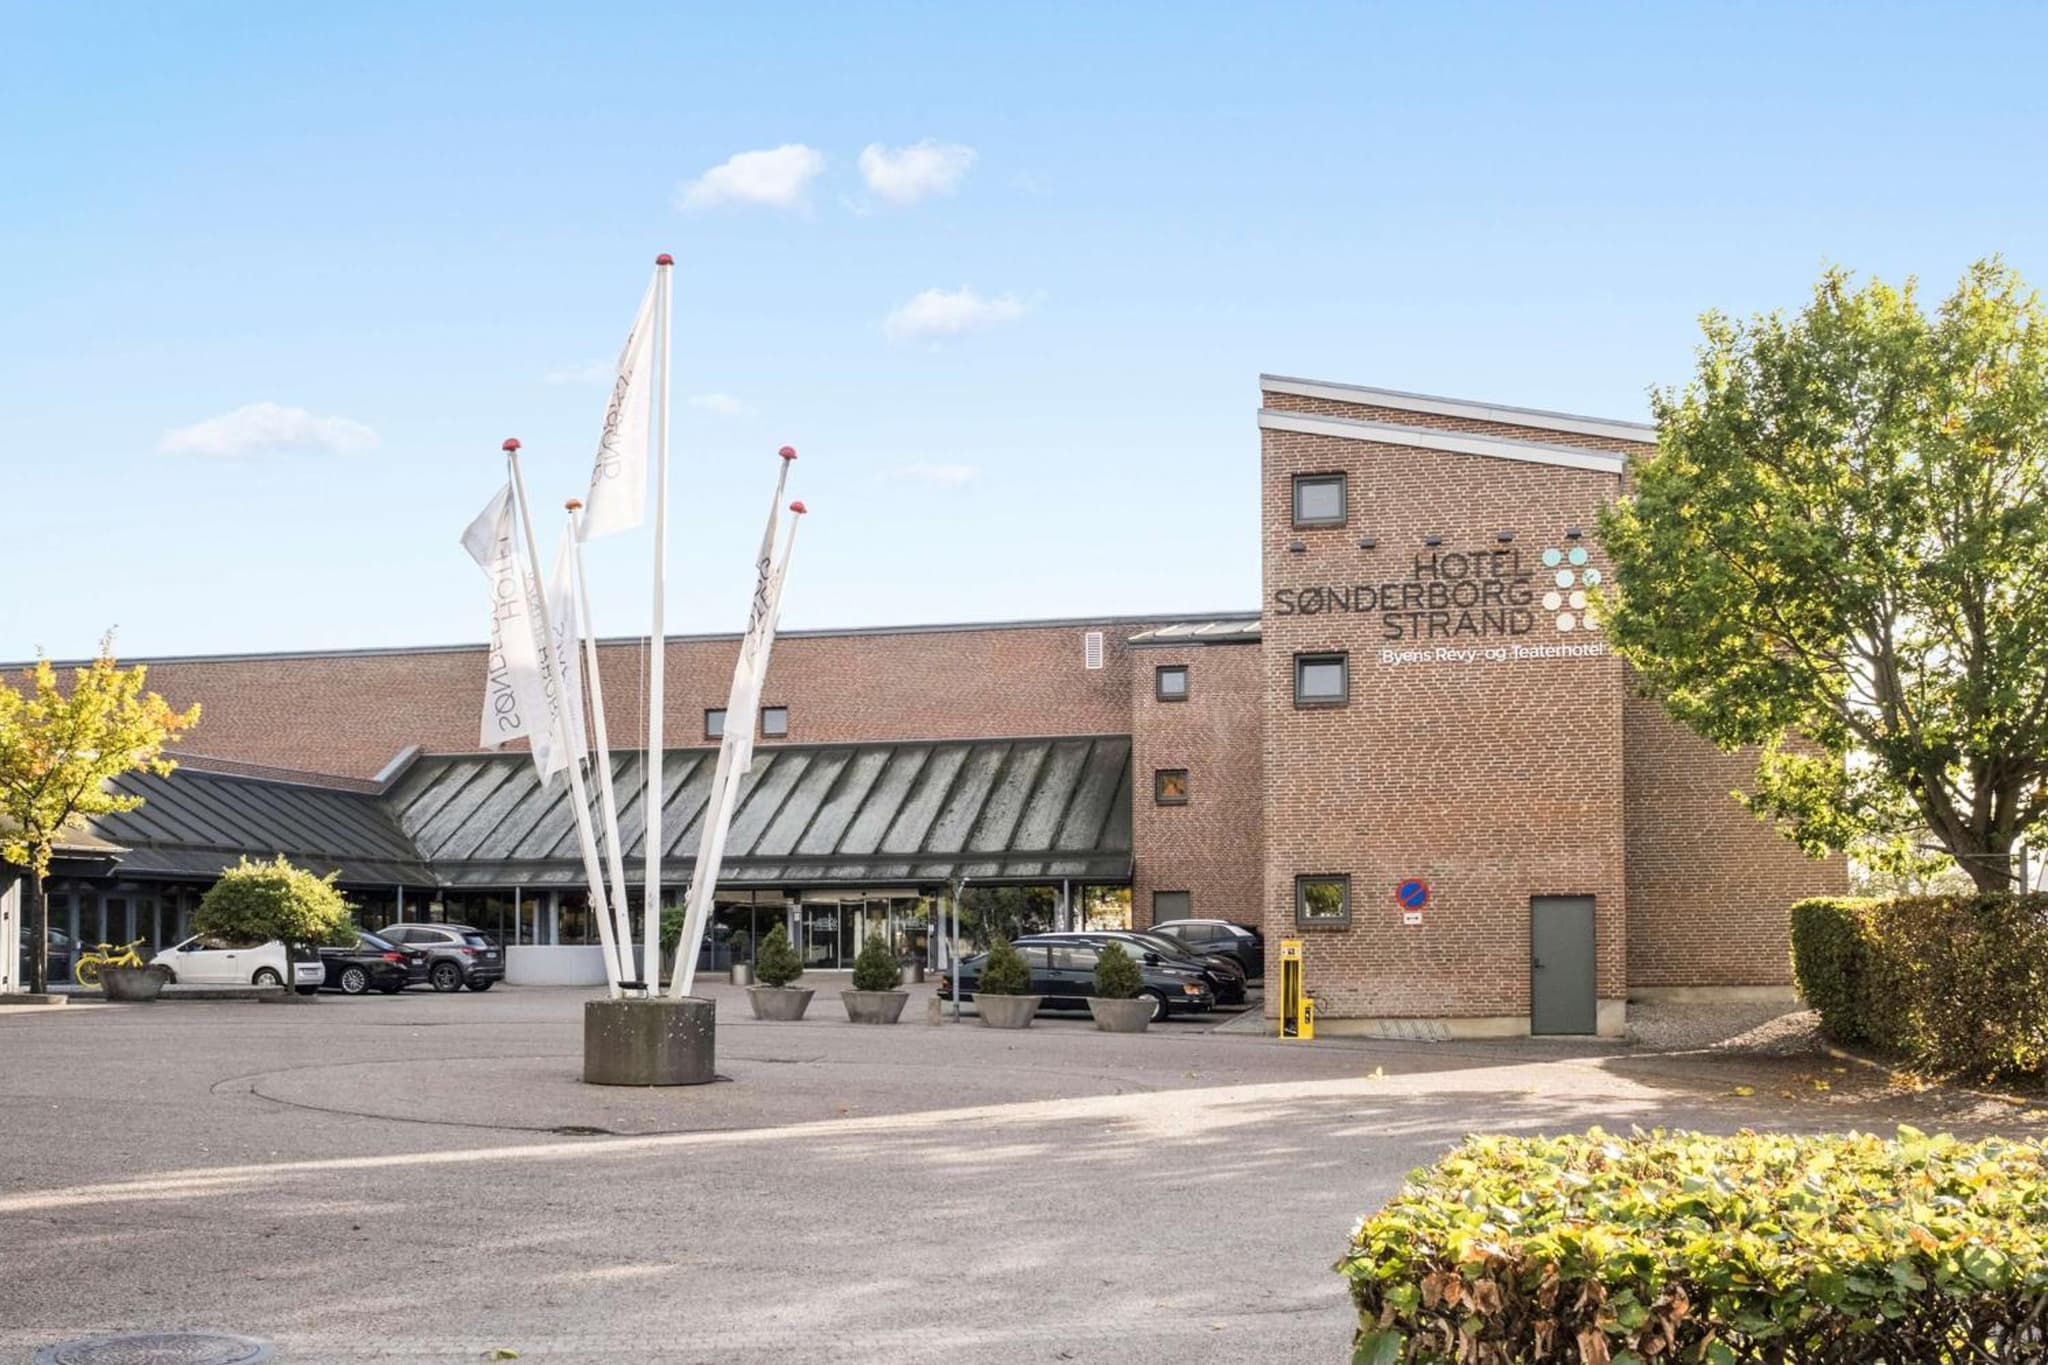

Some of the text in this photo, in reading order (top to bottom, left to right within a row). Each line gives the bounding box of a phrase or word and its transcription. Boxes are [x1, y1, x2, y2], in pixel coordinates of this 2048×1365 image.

[1414, 550, 1534, 580] HOTEL
[1275, 580, 1534, 616] SØNDERBORG
[1383, 609, 1535, 640] STRAND
[1382, 643, 1603, 665] Byens Revy- og Teaterhotel
